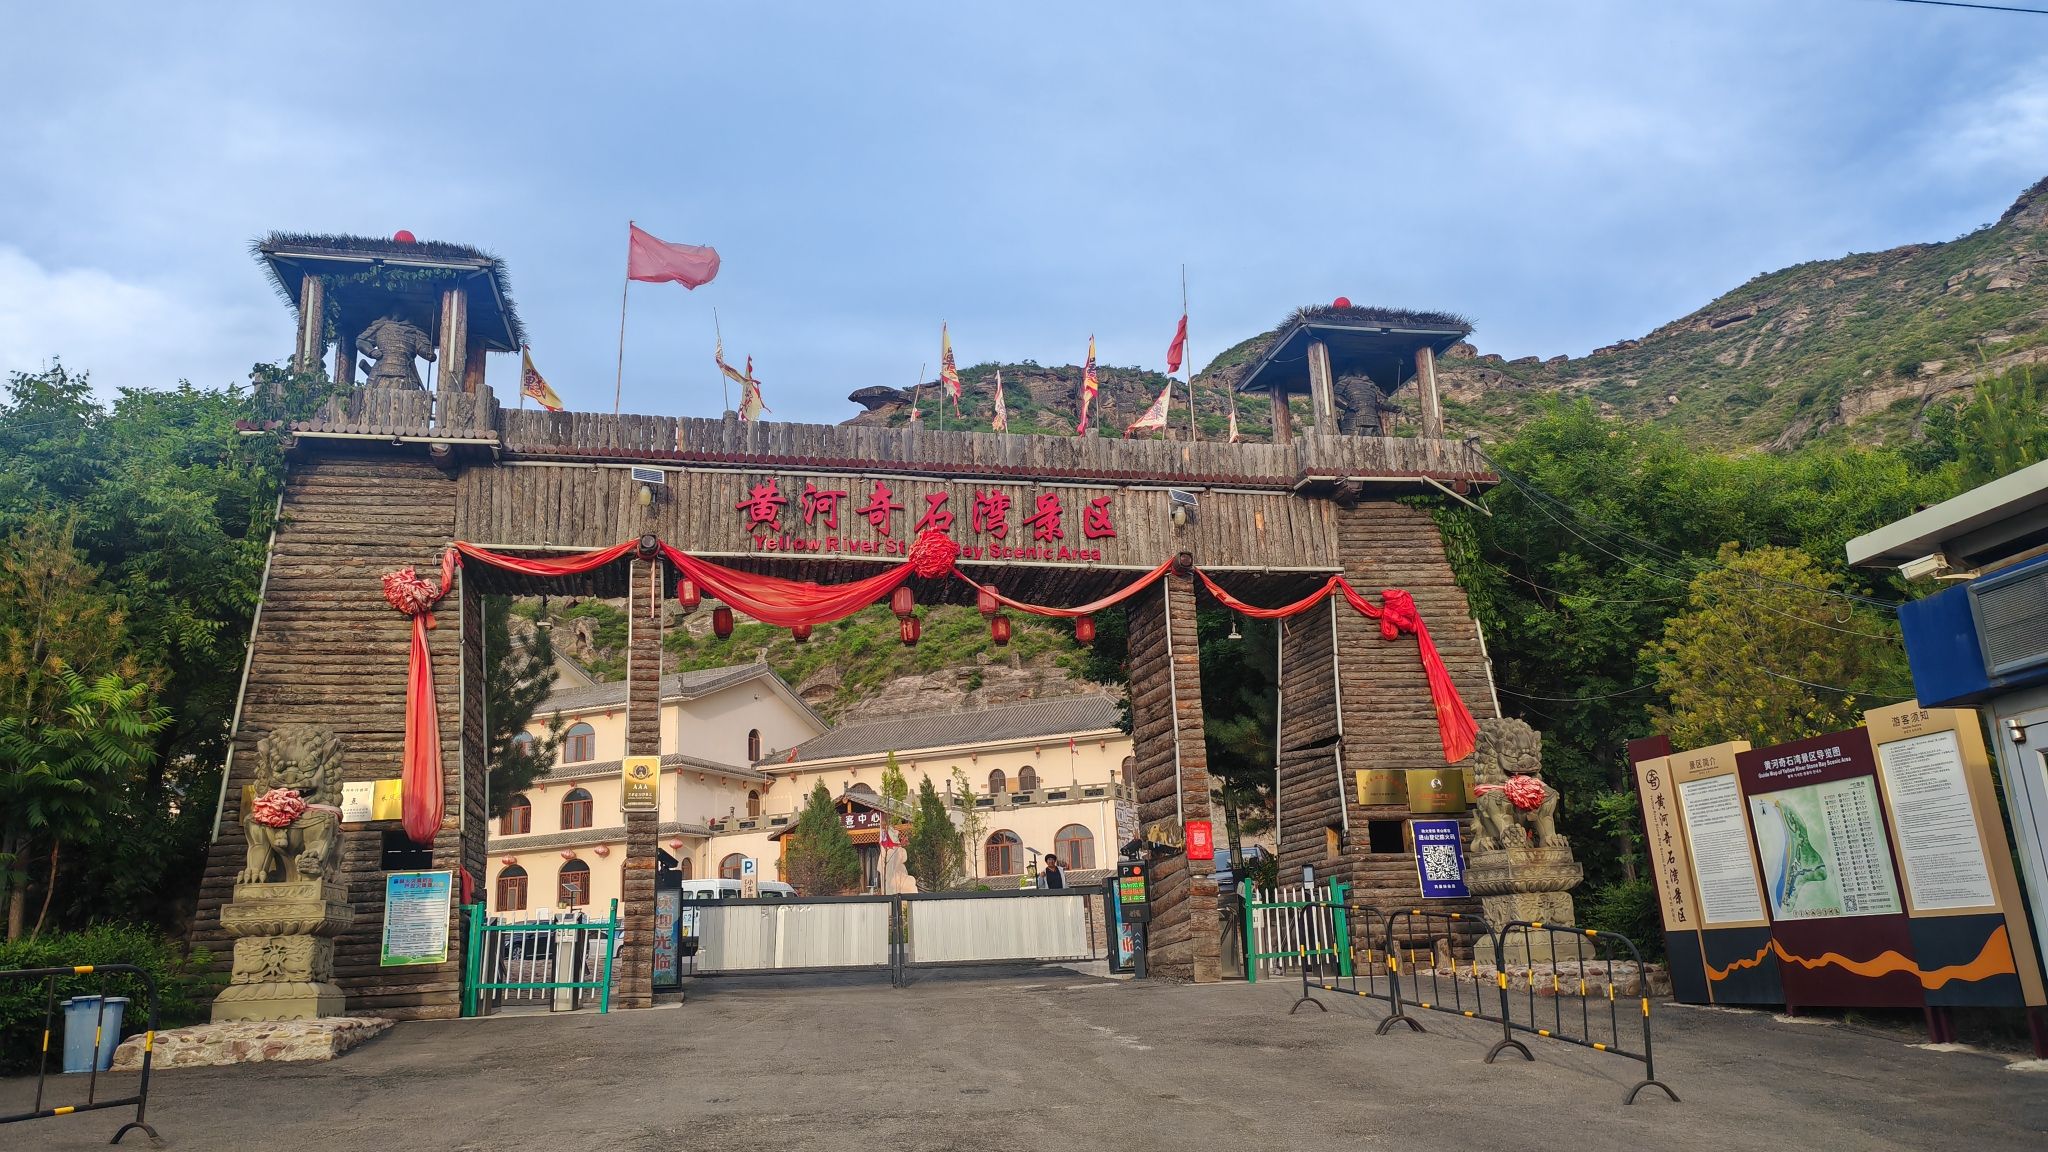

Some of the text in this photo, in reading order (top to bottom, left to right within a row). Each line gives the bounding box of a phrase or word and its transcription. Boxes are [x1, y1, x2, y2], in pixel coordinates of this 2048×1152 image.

[735, 479, 1118, 543] 黄河奇石湾景区
[753, 534, 822, 551] Yellow
[826, 536, 880, 553] River
[989, 543, 1054, 560] Scenic
[1057, 545, 1101, 561] Area
[1892, 710, 1929, 727] 游客须知
[1689, 757, 1716, 770] 景区简介
[1763, 746, 1842, 770] 黄河奇石湾景区导览图
[838, 812, 881, 826] 客中心
[744, 860, 753, 874] P
[1655, 793, 1687, 923] 黄河奇石湾景区
[1122, 866, 1129, 875] P
[655, 895, 673, 971] 欢迎光临
